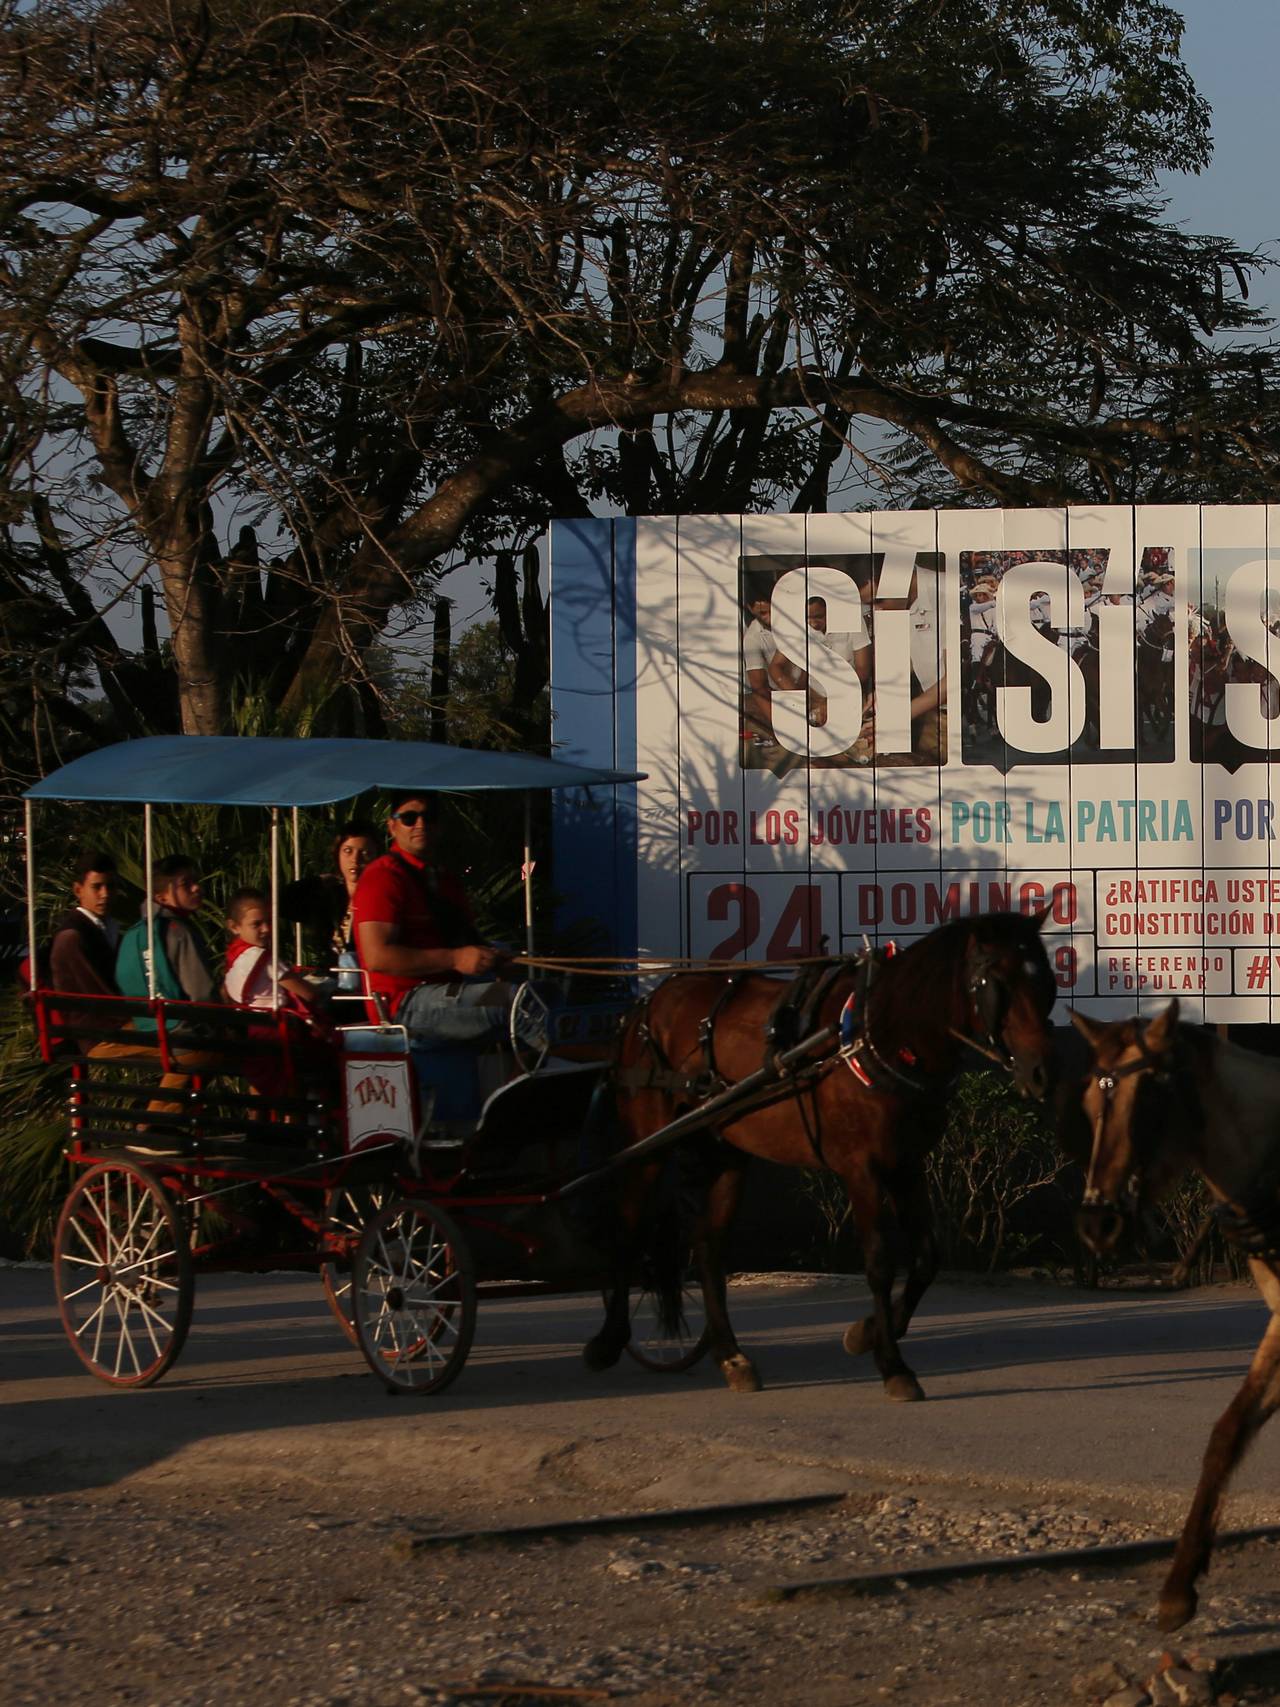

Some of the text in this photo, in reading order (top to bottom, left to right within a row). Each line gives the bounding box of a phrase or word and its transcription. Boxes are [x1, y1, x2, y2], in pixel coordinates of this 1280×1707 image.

[687, 810, 740, 845] POR
[750, 809, 799, 845] LOS
[810, 804, 932, 845] JÓVENES
[951, 801, 1012, 844] POR
[1026, 801, 1065, 843] LA
[1077, 799, 1194, 842] PATRIA
[1214, 799, 1276, 841] POR
[858, 882, 1077, 925] DOMINGO
[1105, 880, 1218, 906] ¿RATIFICA
[707, 883, 829, 966] 24
[1105, 910, 1254, 935] CONSTITUCIÓN
[1108, 957, 1223, 972] REFERENDO
[1109, 975, 1207, 990] POPULAR
[354, 1075, 397, 1109] TAXI
